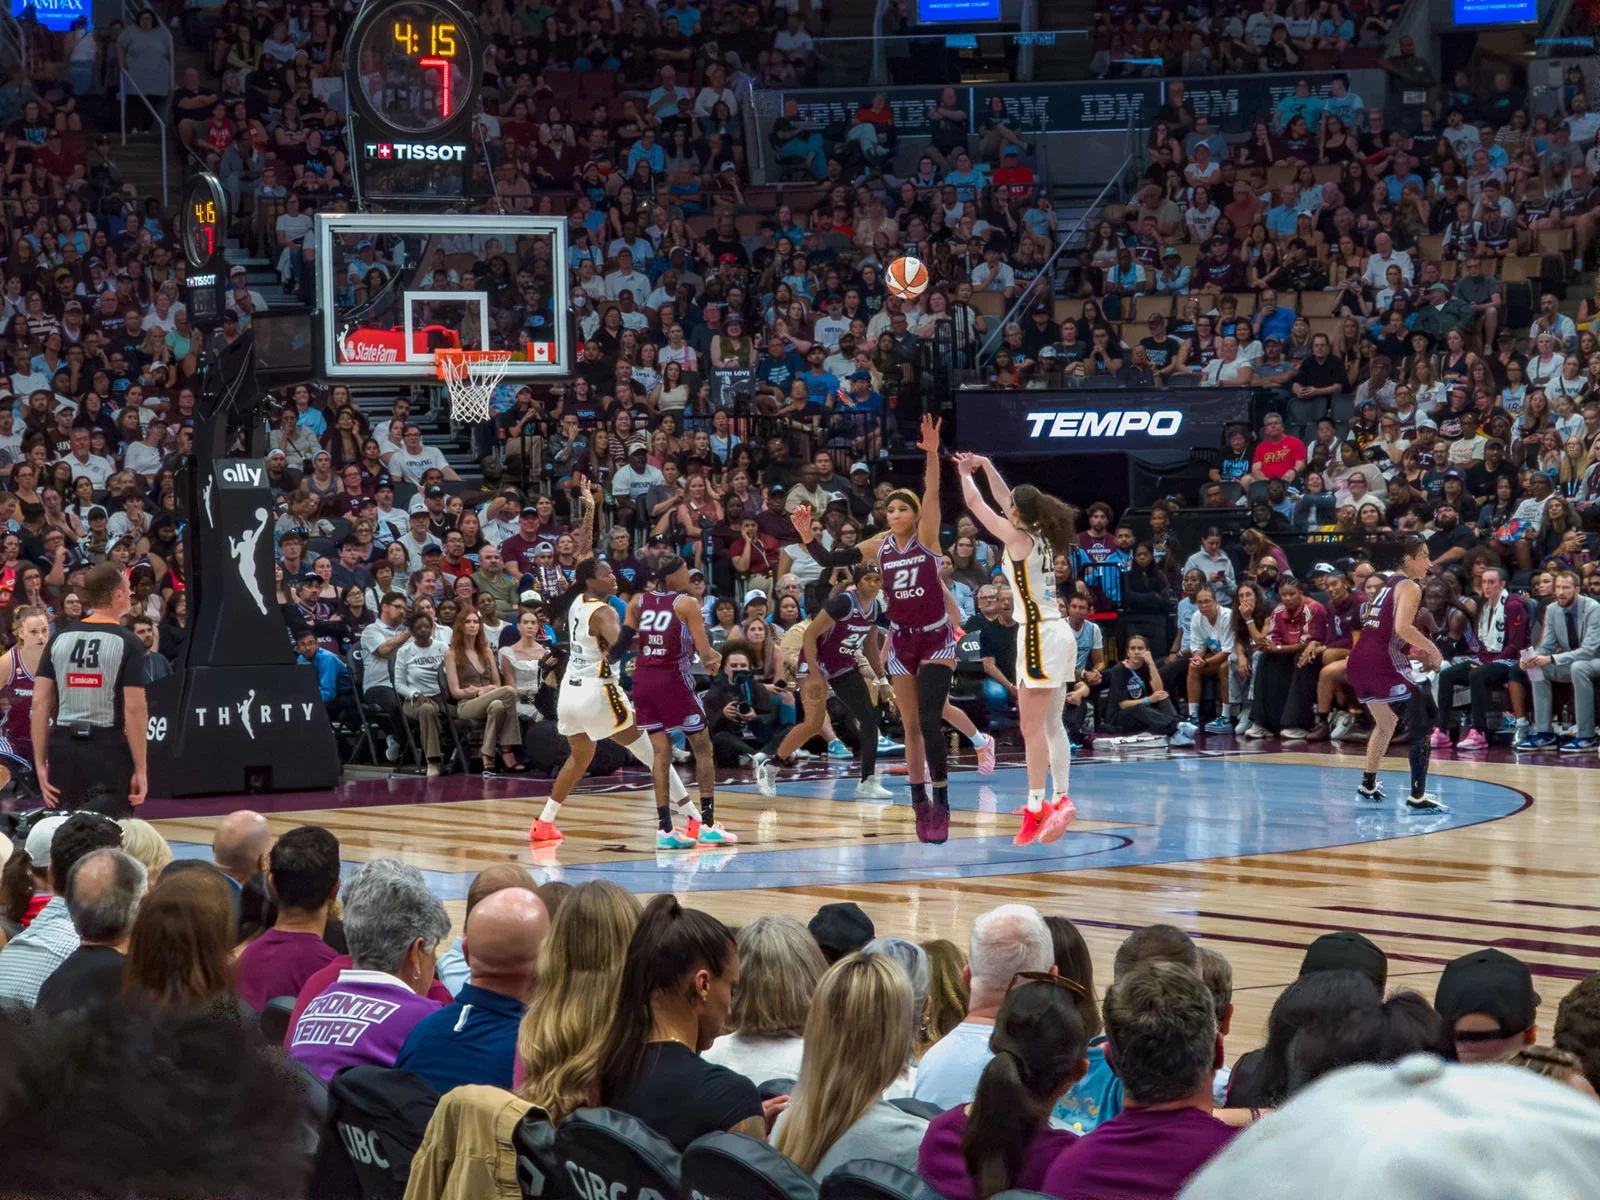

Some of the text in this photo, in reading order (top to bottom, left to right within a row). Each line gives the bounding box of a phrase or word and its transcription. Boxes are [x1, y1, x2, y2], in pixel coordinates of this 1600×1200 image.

[394, 22, 456, 56] 4:15
[420, 57, 449, 118] 7
[985, 96, 1049, 124] BM
[1080, 93, 1145, 120] IBM
[393, 143, 466, 160] TISSOT
[194, 274, 216, 287] TISSOT
[1026, 410, 1183, 438] TEMPO
[223, 464, 261, 487] ally
[883, 554, 926, 571] TORONTO
[892, 567, 919, 590] 21
[639, 609, 673, 632] 20
[70, 638, 102, 669] 43
[961, 641, 981, 652] CIB
[70, 676, 99, 685] Emirates
[301, 992, 400, 1024] ORONTO
[338, 1121, 390, 1169] CIBC
